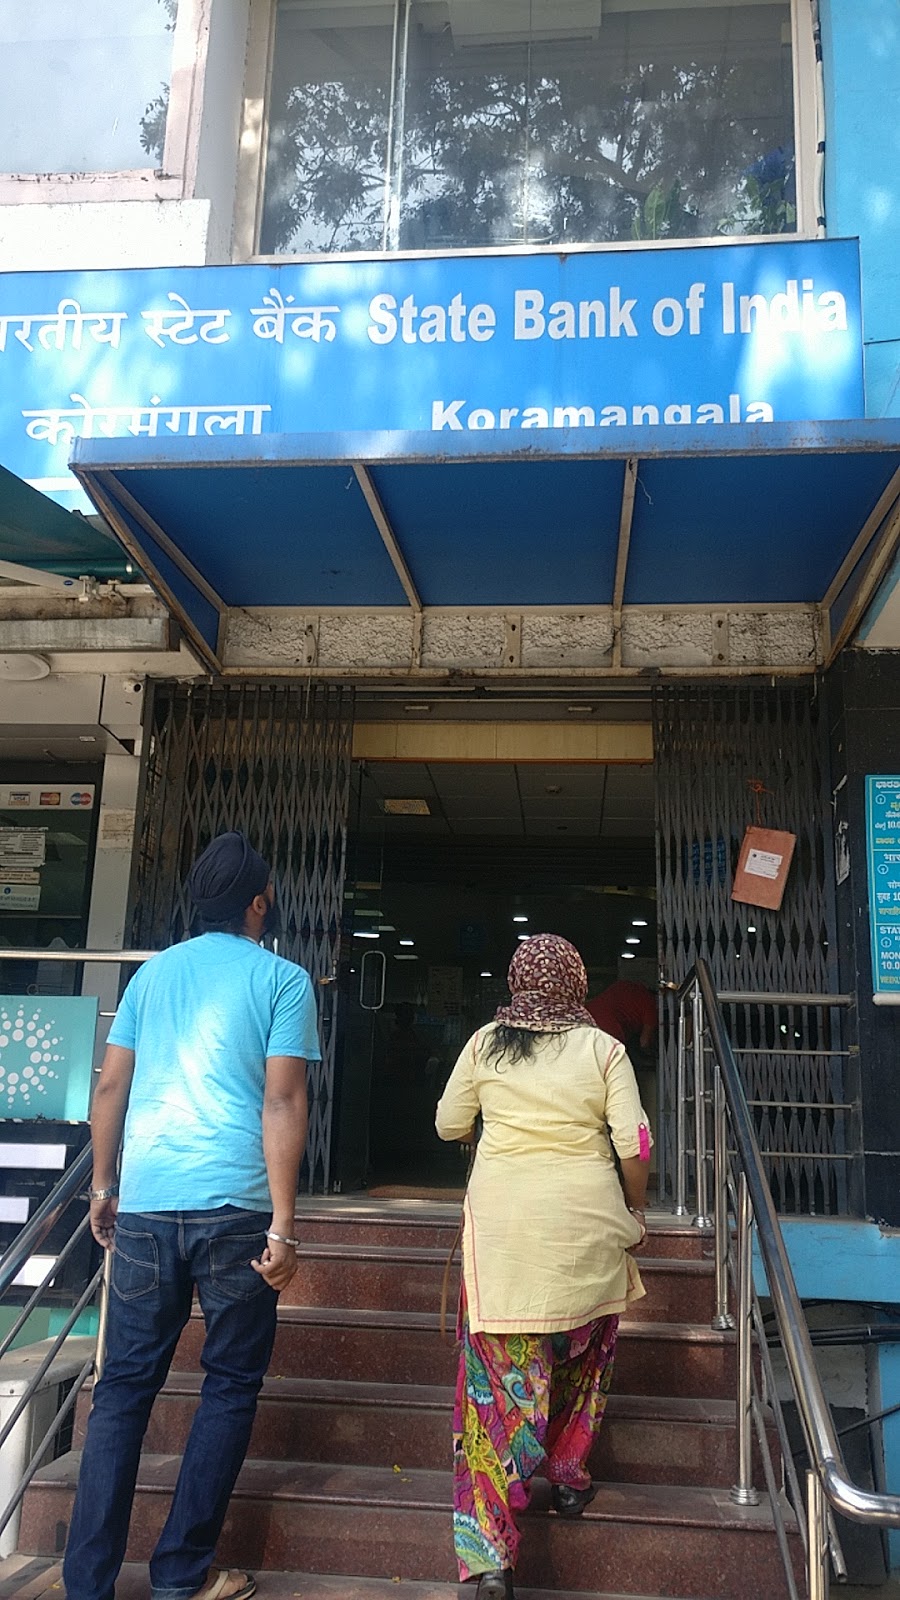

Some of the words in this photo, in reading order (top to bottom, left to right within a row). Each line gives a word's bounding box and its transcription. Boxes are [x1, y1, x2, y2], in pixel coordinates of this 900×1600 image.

[0, 299, 128, 352] ारतीय
[140, 292, 232, 348] स्टेट
[249, 288, 341, 344] बैंक
[367, 292, 496, 344] State
[514, 286, 640, 340] Bank
[652, 284, 705, 336] of
[722, 279, 848, 334] India
[431, 394, 774, 430] Koramangala
